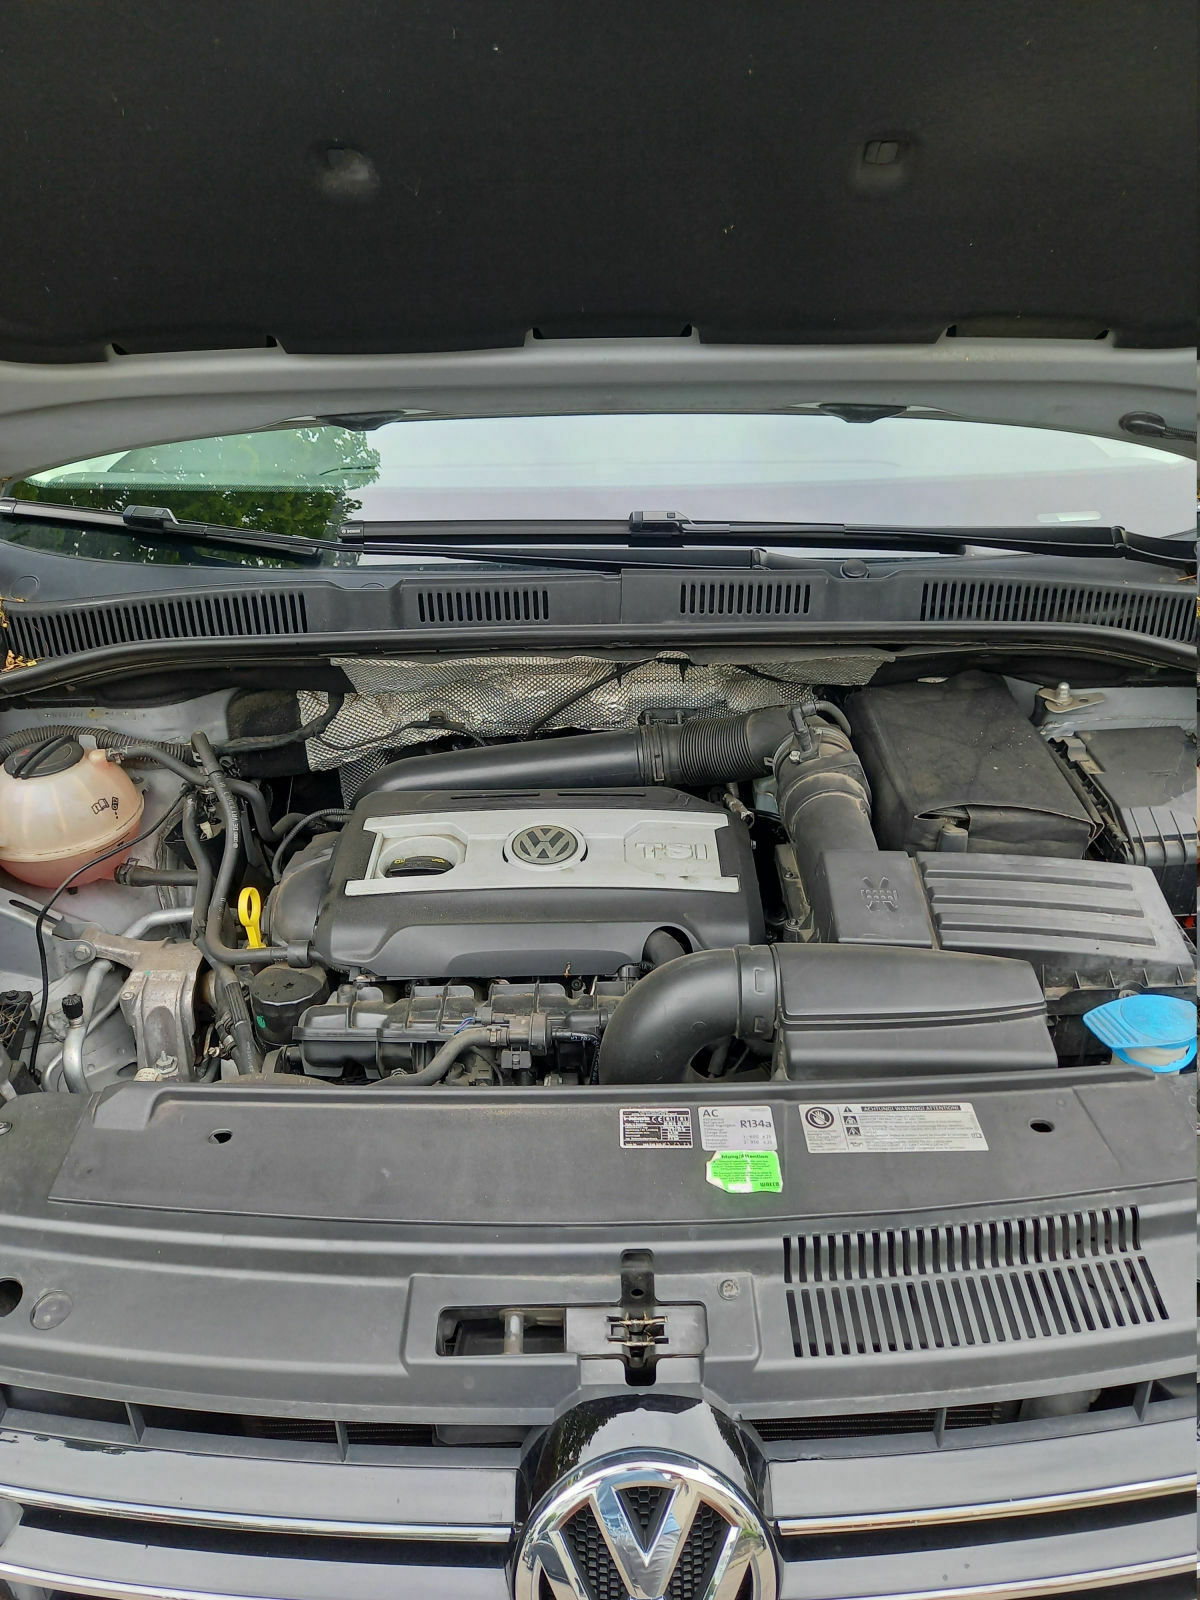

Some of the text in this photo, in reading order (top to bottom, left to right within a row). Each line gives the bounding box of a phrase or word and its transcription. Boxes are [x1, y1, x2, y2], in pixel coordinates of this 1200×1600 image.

[635, 842, 708, 860] TSI
[703, 1109, 719, 1118] AC
[740, 1119, 772, 1128] R134a
